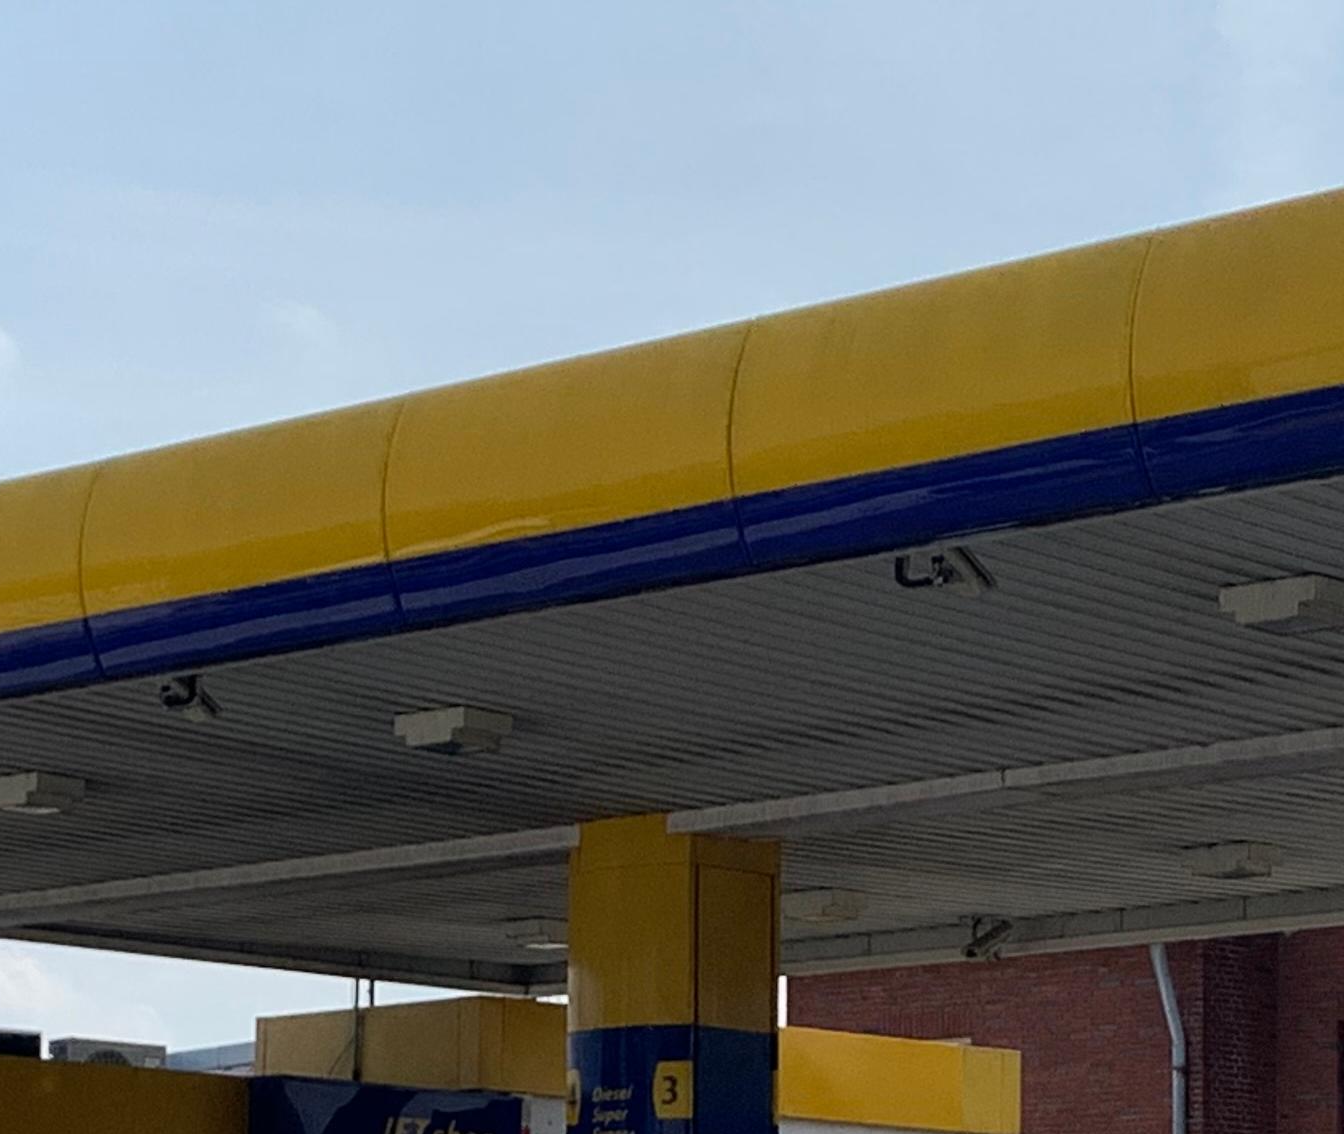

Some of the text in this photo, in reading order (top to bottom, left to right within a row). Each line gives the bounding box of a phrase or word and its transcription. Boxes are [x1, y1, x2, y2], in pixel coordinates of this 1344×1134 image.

[591, 1082, 634, 1103] Diesel
[661, 1075, 678, 1105] 3
[591, 1105, 629, 1128] Super
